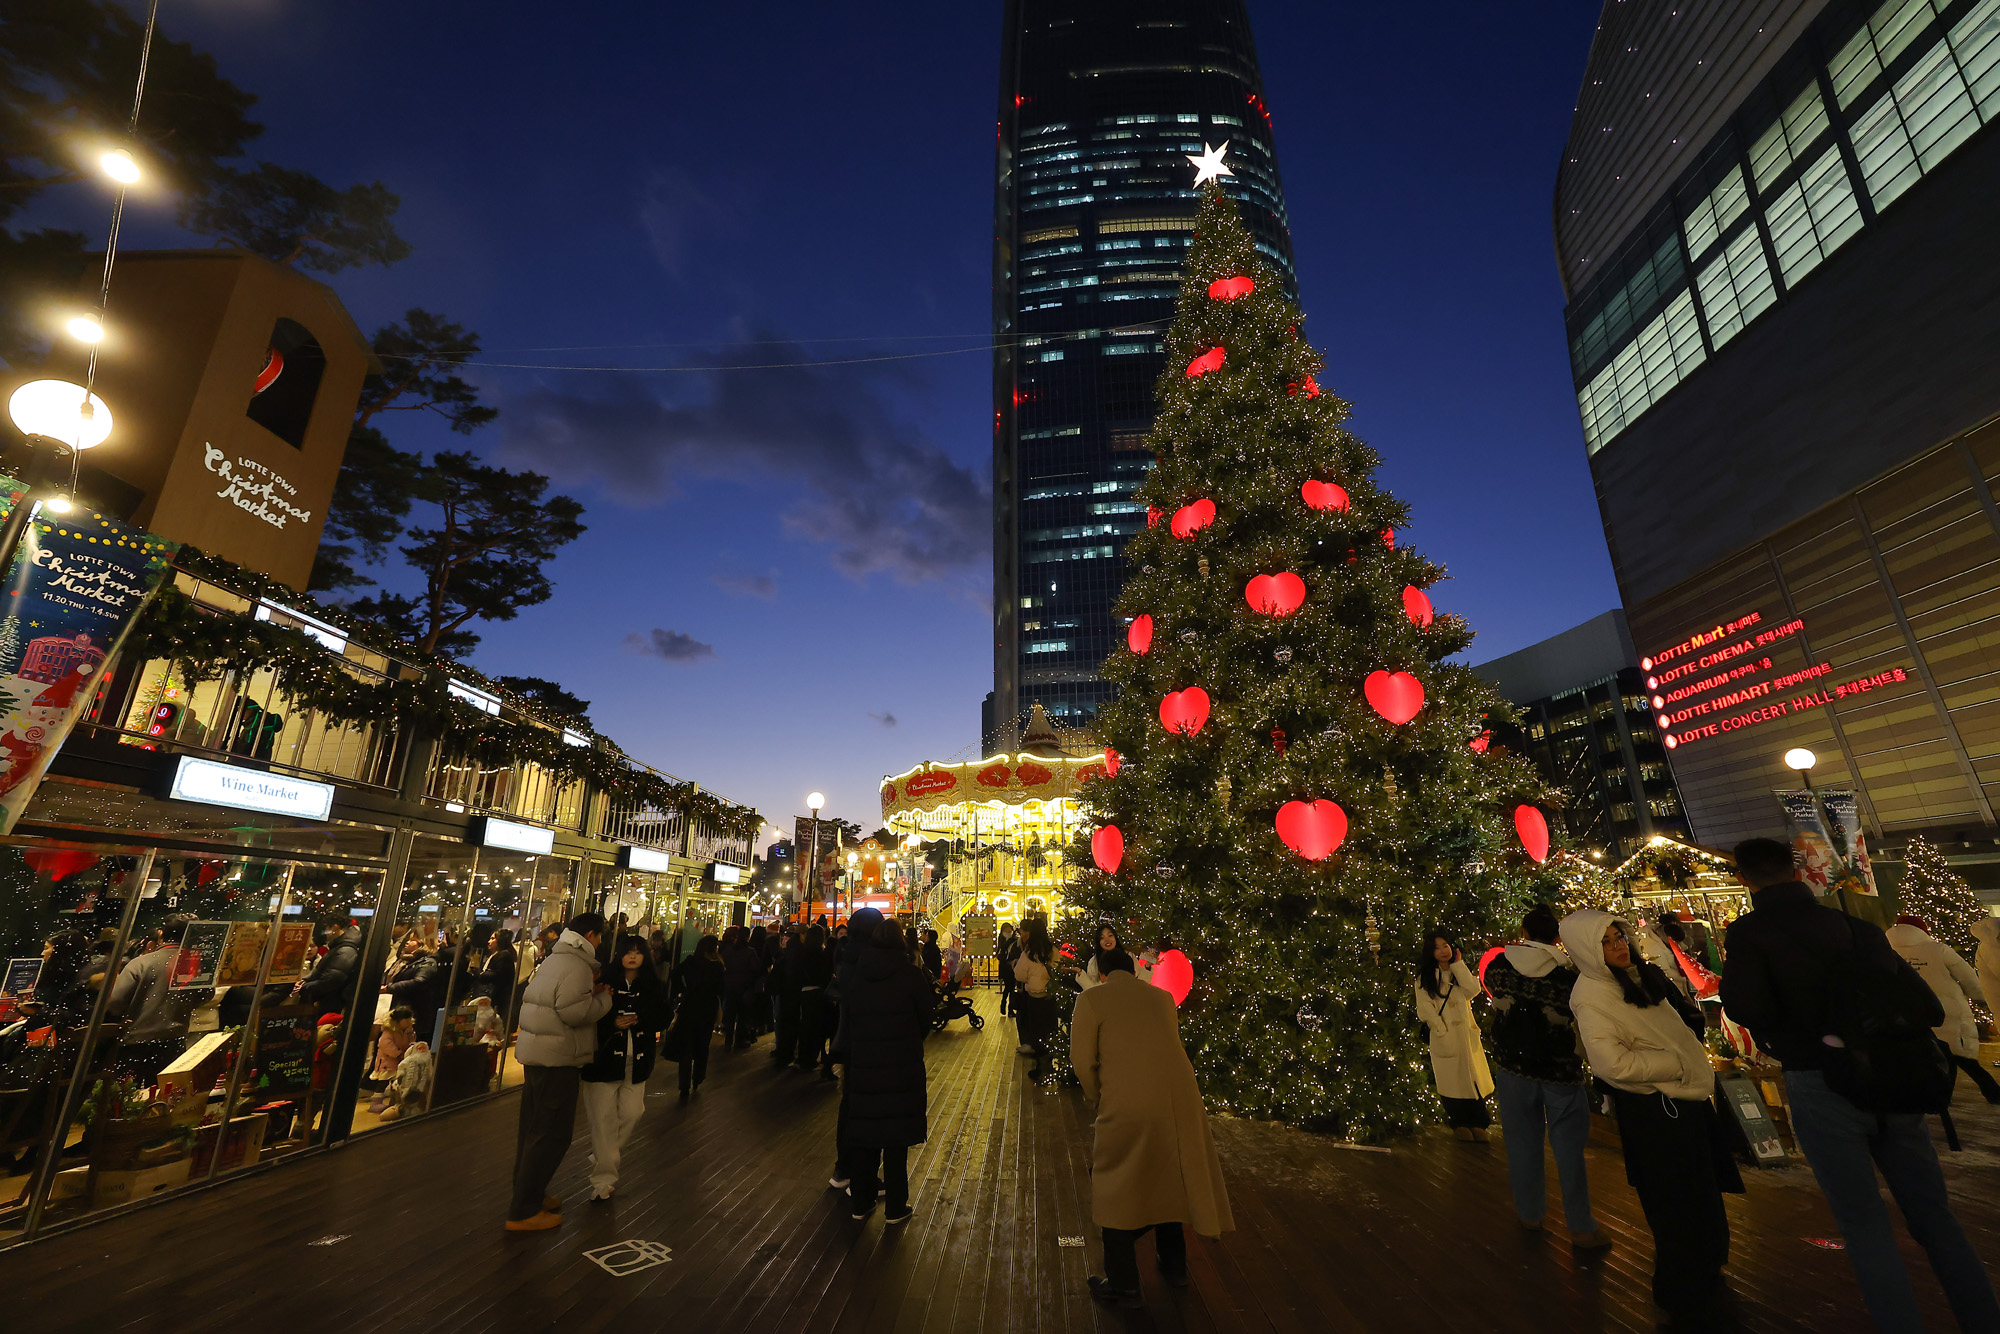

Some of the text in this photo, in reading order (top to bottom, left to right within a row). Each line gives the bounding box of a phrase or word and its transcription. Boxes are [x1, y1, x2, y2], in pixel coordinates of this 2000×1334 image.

[204, 441, 311, 523] Christmas
[238, 456, 297, 496] LOTTE TOWN
[216, 483, 287, 530] Market
[31, 545, 150, 600] Christmas
[69, 553, 136, 580] LOTTE TOWN
[46, 574, 126, 607] Market
[1653, 641, 1692, 666] LOTTE
[1690, 625, 1726, 650] Mart
[1658, 619, 1805, 685] LOTTE CINEMA 롯데시네마
[1666, 672, 1730, 703] AQUARIUM
[1670, 662, 1833, 724] LOTTE HIMART 롯데하이마트
[1677, 668, 1907, 744] LOTTE CONCERT HALL 롯데콘서트홀
[221, 776, 299, 801] Wine Market
[284, 930, 303, 942] 뱅쇼
[269, 1060, 299, 1071] Special
